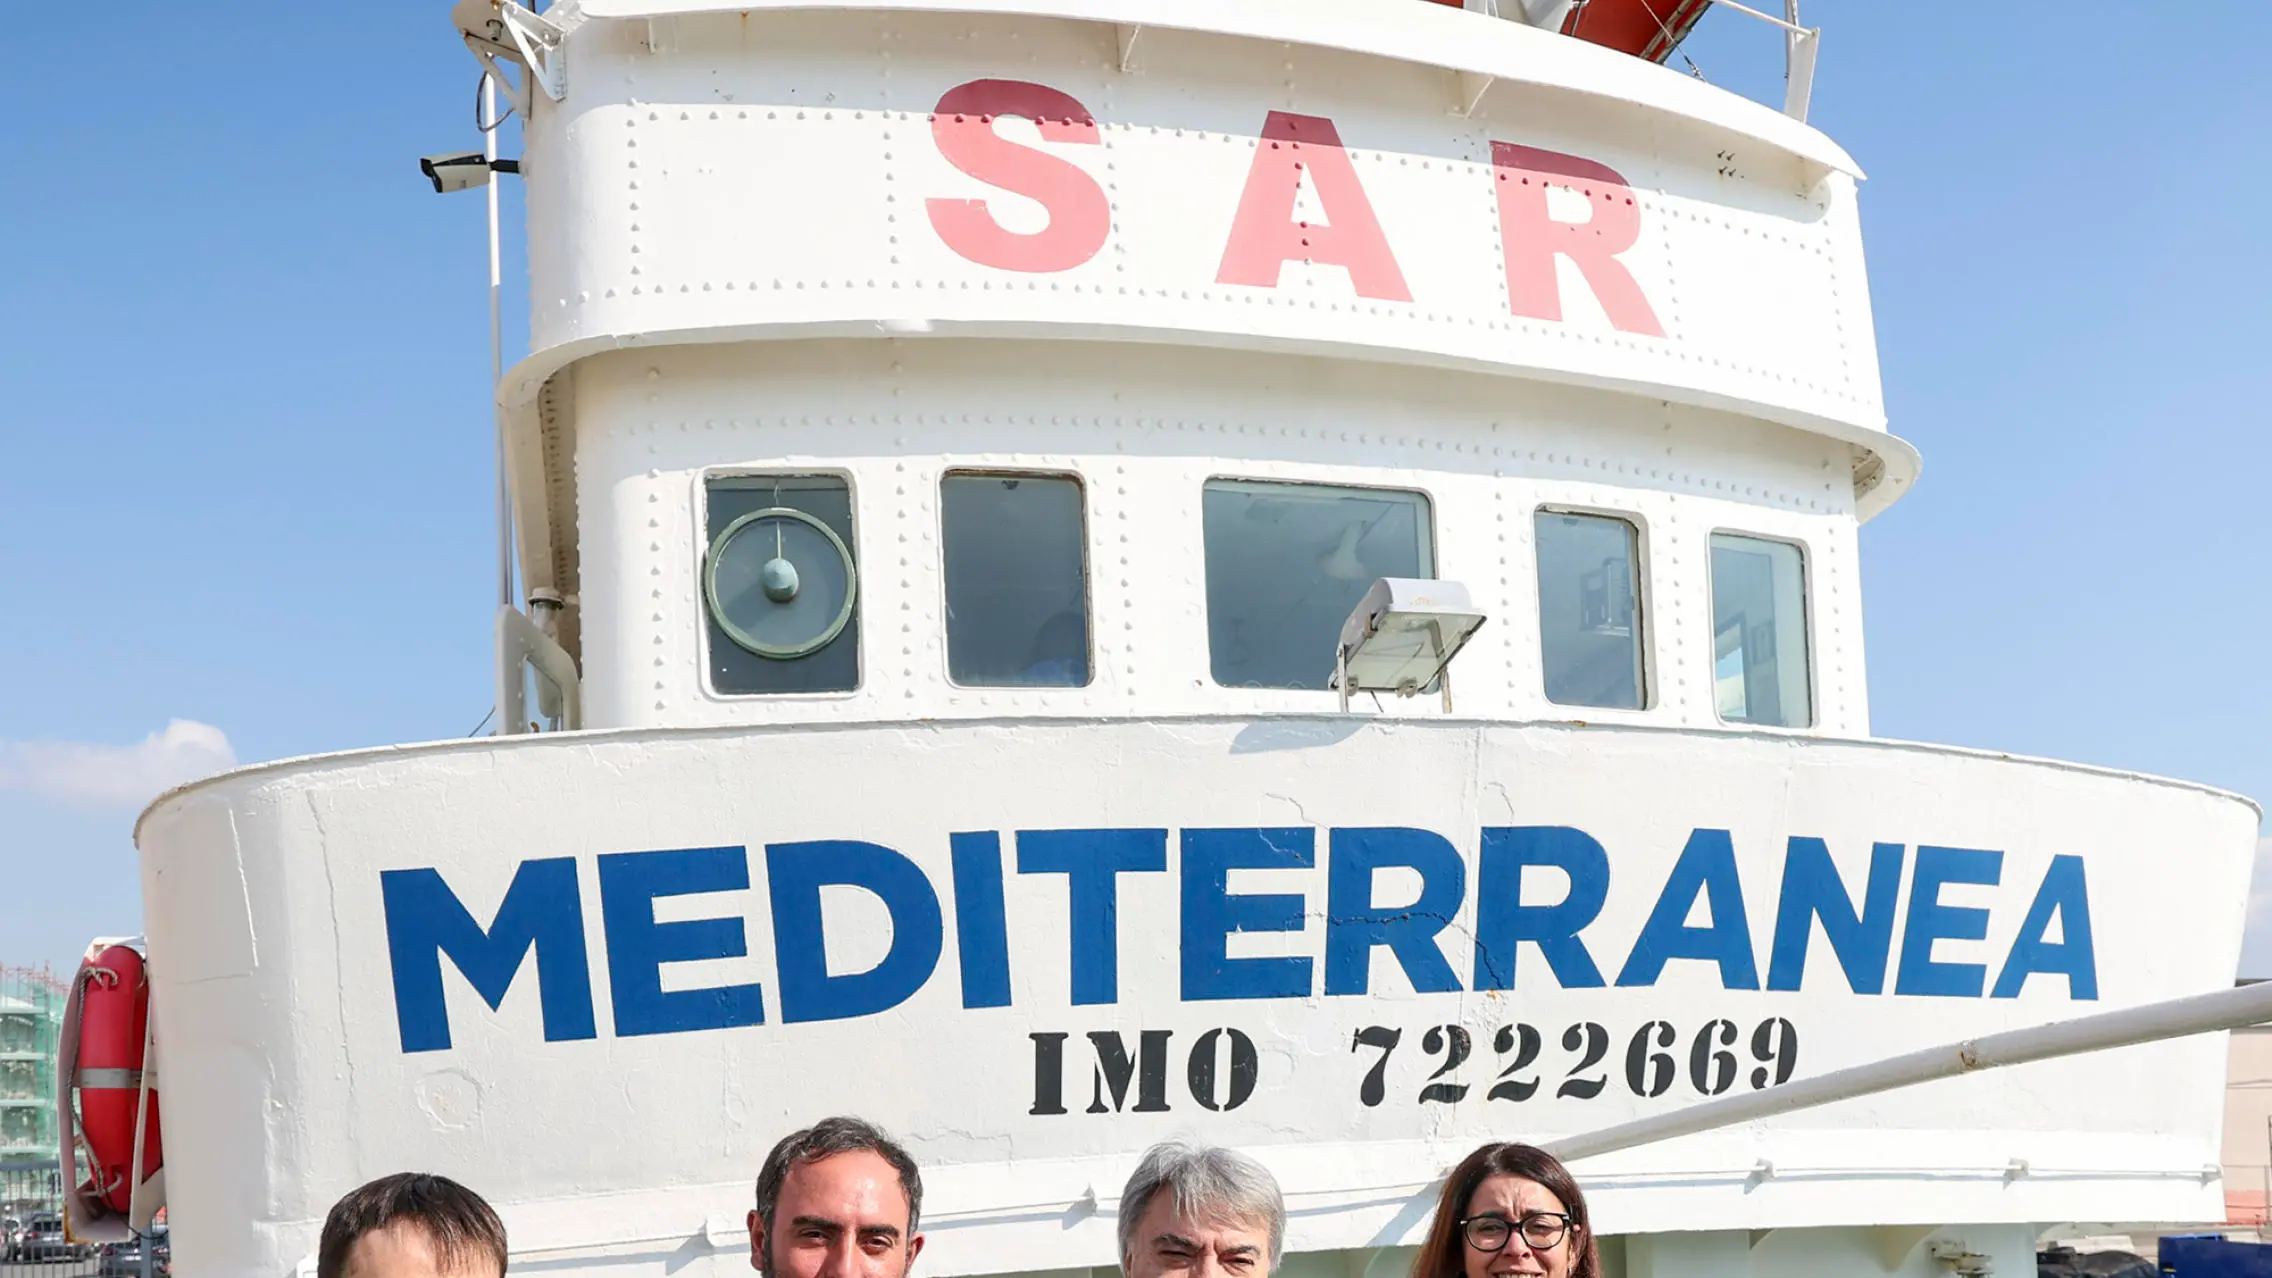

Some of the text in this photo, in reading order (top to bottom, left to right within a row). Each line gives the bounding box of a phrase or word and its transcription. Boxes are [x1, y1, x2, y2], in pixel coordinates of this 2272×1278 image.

[925, 79, 1668, 338] SAR
[381, 826, 2099, 1053] MEDITERRANEA
[1028, 1017, 1799, 1115] IMO 7222669
